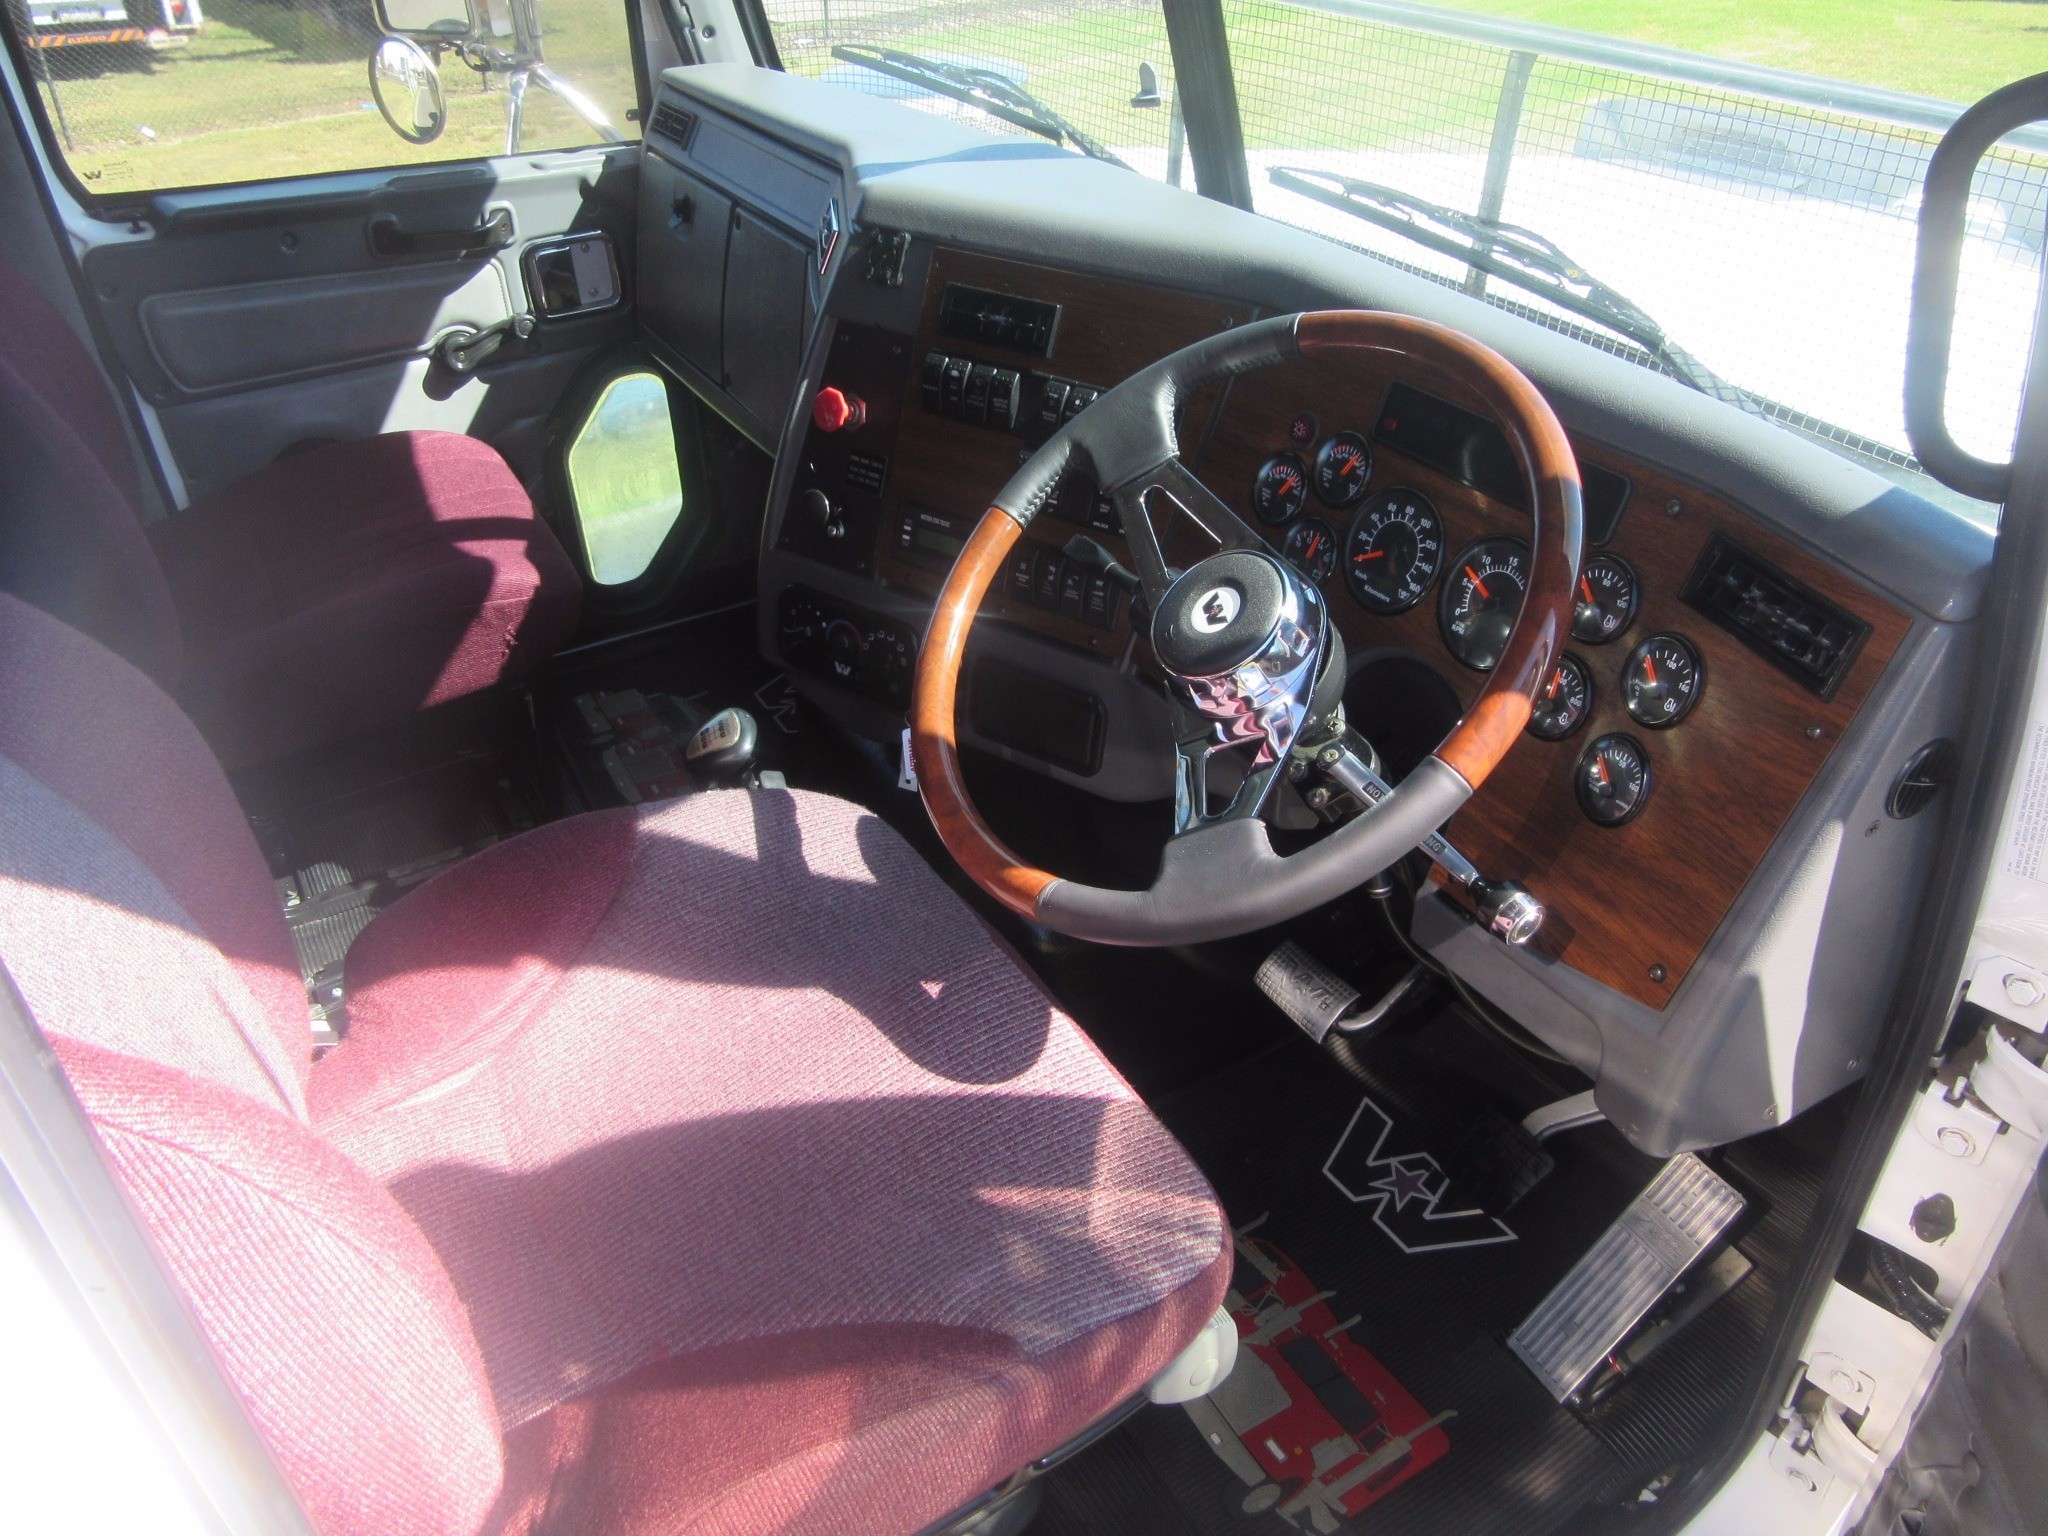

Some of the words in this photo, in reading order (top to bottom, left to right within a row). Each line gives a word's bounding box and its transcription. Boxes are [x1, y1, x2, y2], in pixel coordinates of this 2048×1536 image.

[1388, 503, 1397, 512] 60
[1405, 505, 1415, 515] 80
[1370, 513, 1380, 522] 40
[1420, 518, 1432, 528] 100
[1358, 531, 1367, 541] 20
[1425, 540, 1437, 551] 120
[1481, 554, 1491, 564] 10
[1509, 556, 1519, 566] 15
[1421, 562, 1433, 574] 140
[1462, 577, 1468, 585] 5
[1602, 577, 1611, 587] 80
[1409, 581, 1421, 594] 160
[1616, 599, 1627, 609] 120
[1455, 607, 1461, 616] 0
[1451, 624, 1465, 635] RPM
[1665, 659, 1678, 670] 100
[1678, 681, 1690, 694] 160
[1569, 696, 1582, 708] 800
[1618, 759, 1627, 769] 50
[1628, 782, 1639, 793] 100
